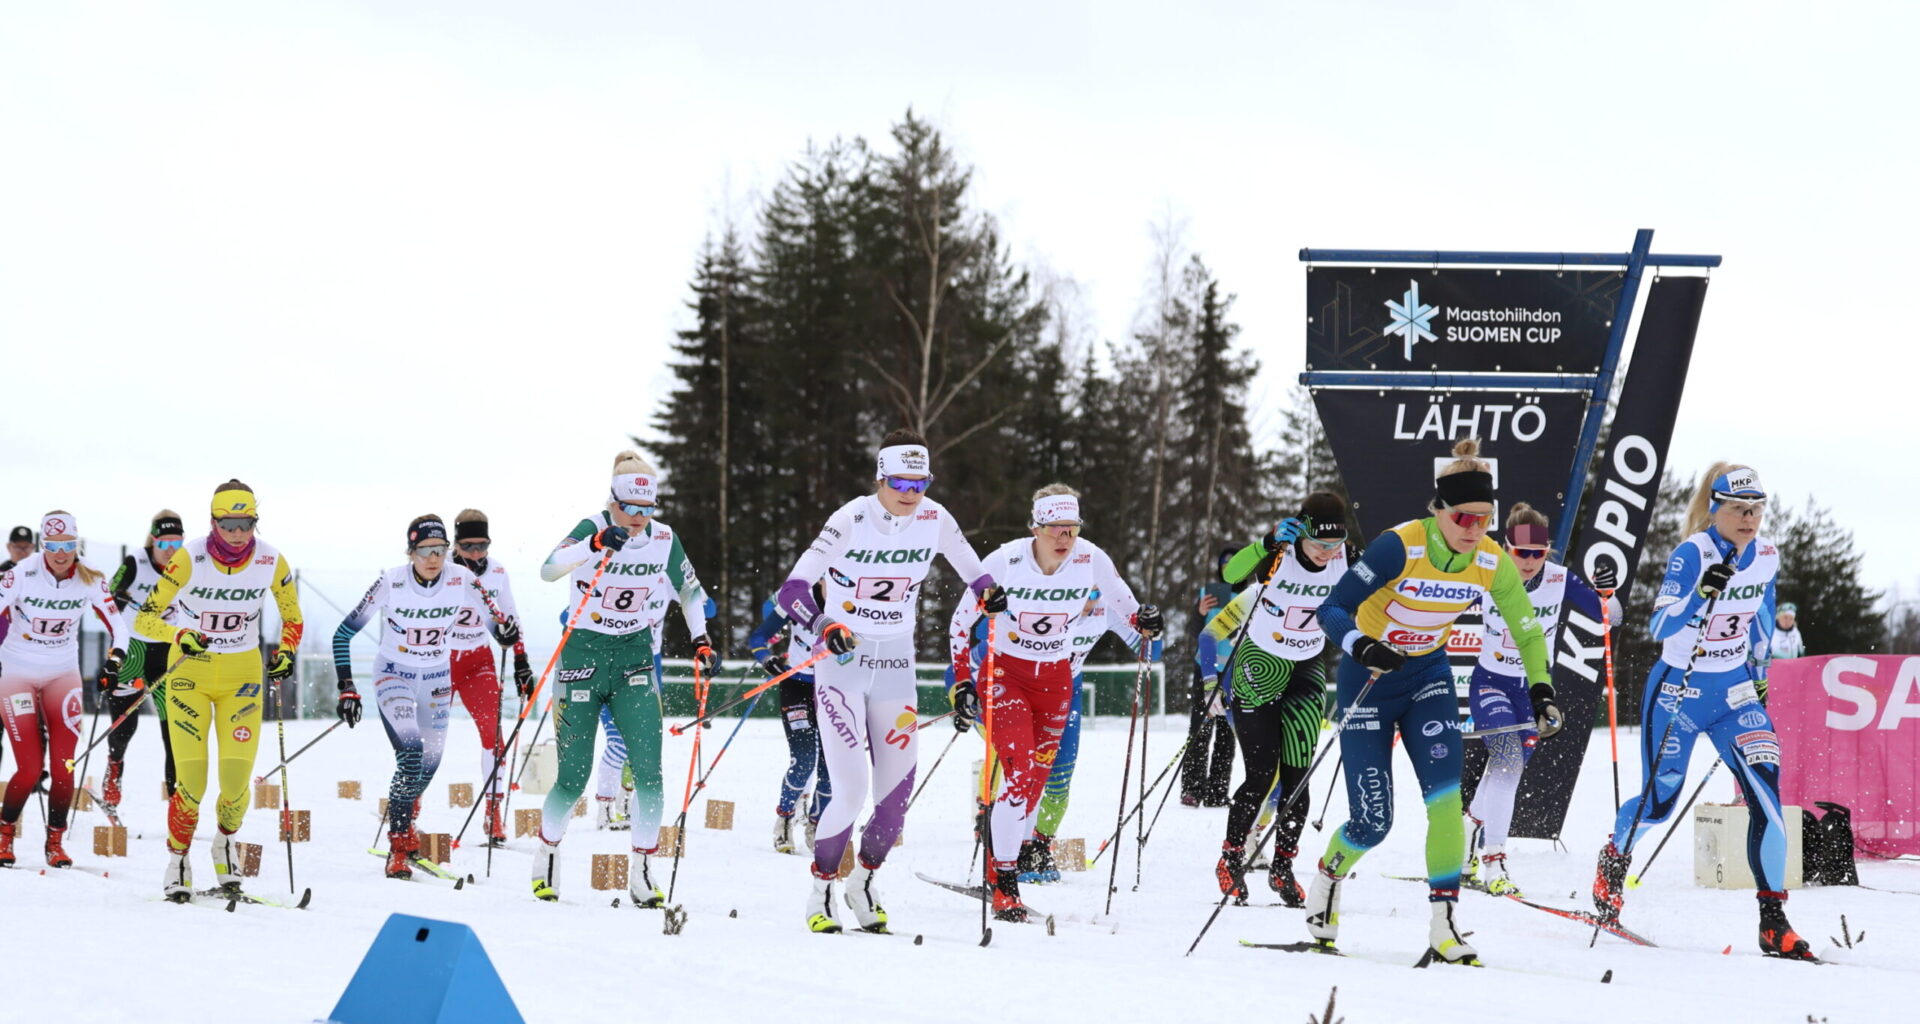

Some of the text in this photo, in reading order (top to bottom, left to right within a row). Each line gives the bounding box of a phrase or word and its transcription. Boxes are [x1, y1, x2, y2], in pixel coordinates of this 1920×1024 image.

[1446, 307, 1561, 322] Maastohiihdon
[1446, 326, 1561, 343] SUOMEN CUP
[1394, 395, 1547, 442] LÄHTÖ
[1731, 478, 1752, 488] MKP
[844, 548, 932, 564] HiKOKI
[189, 586, 266, 601] HiKOKI
[870, 581, 896, 601] 2
[1005, 586, 1089, 601] HiKOKI
[1276, 579, 1336, 597] HiKO
[1398, 579, 1482, 600] Webasto
[1718, 583, 1764, 601] iKOK
[614, 590, 635, 610] 8
[1298, 609, 1317, 629] 7
[1489, 604, 1559, 618] HOKI
[39, 620, 67, 634] 14
[209, 614, 242, 631] 10
[1031, 616, 1052, 635] 6
[1720, 615, 1741, 638] 3
[413, 629, 441, 646] 12
[859, 654, 910, 670] Fennoa
[399, 670, 417, 680] TOI
[559, 668, 595, 682] TEHO
[1662, 684, 1698, 697] EQVTIA
[170, 695, 200, 719] TRIMTEX
[817, 684, 858, 749] VUOKATTI
[1366, 766, 1386, 832] KAINUU
[1716, 863, 1723, 884] 6
